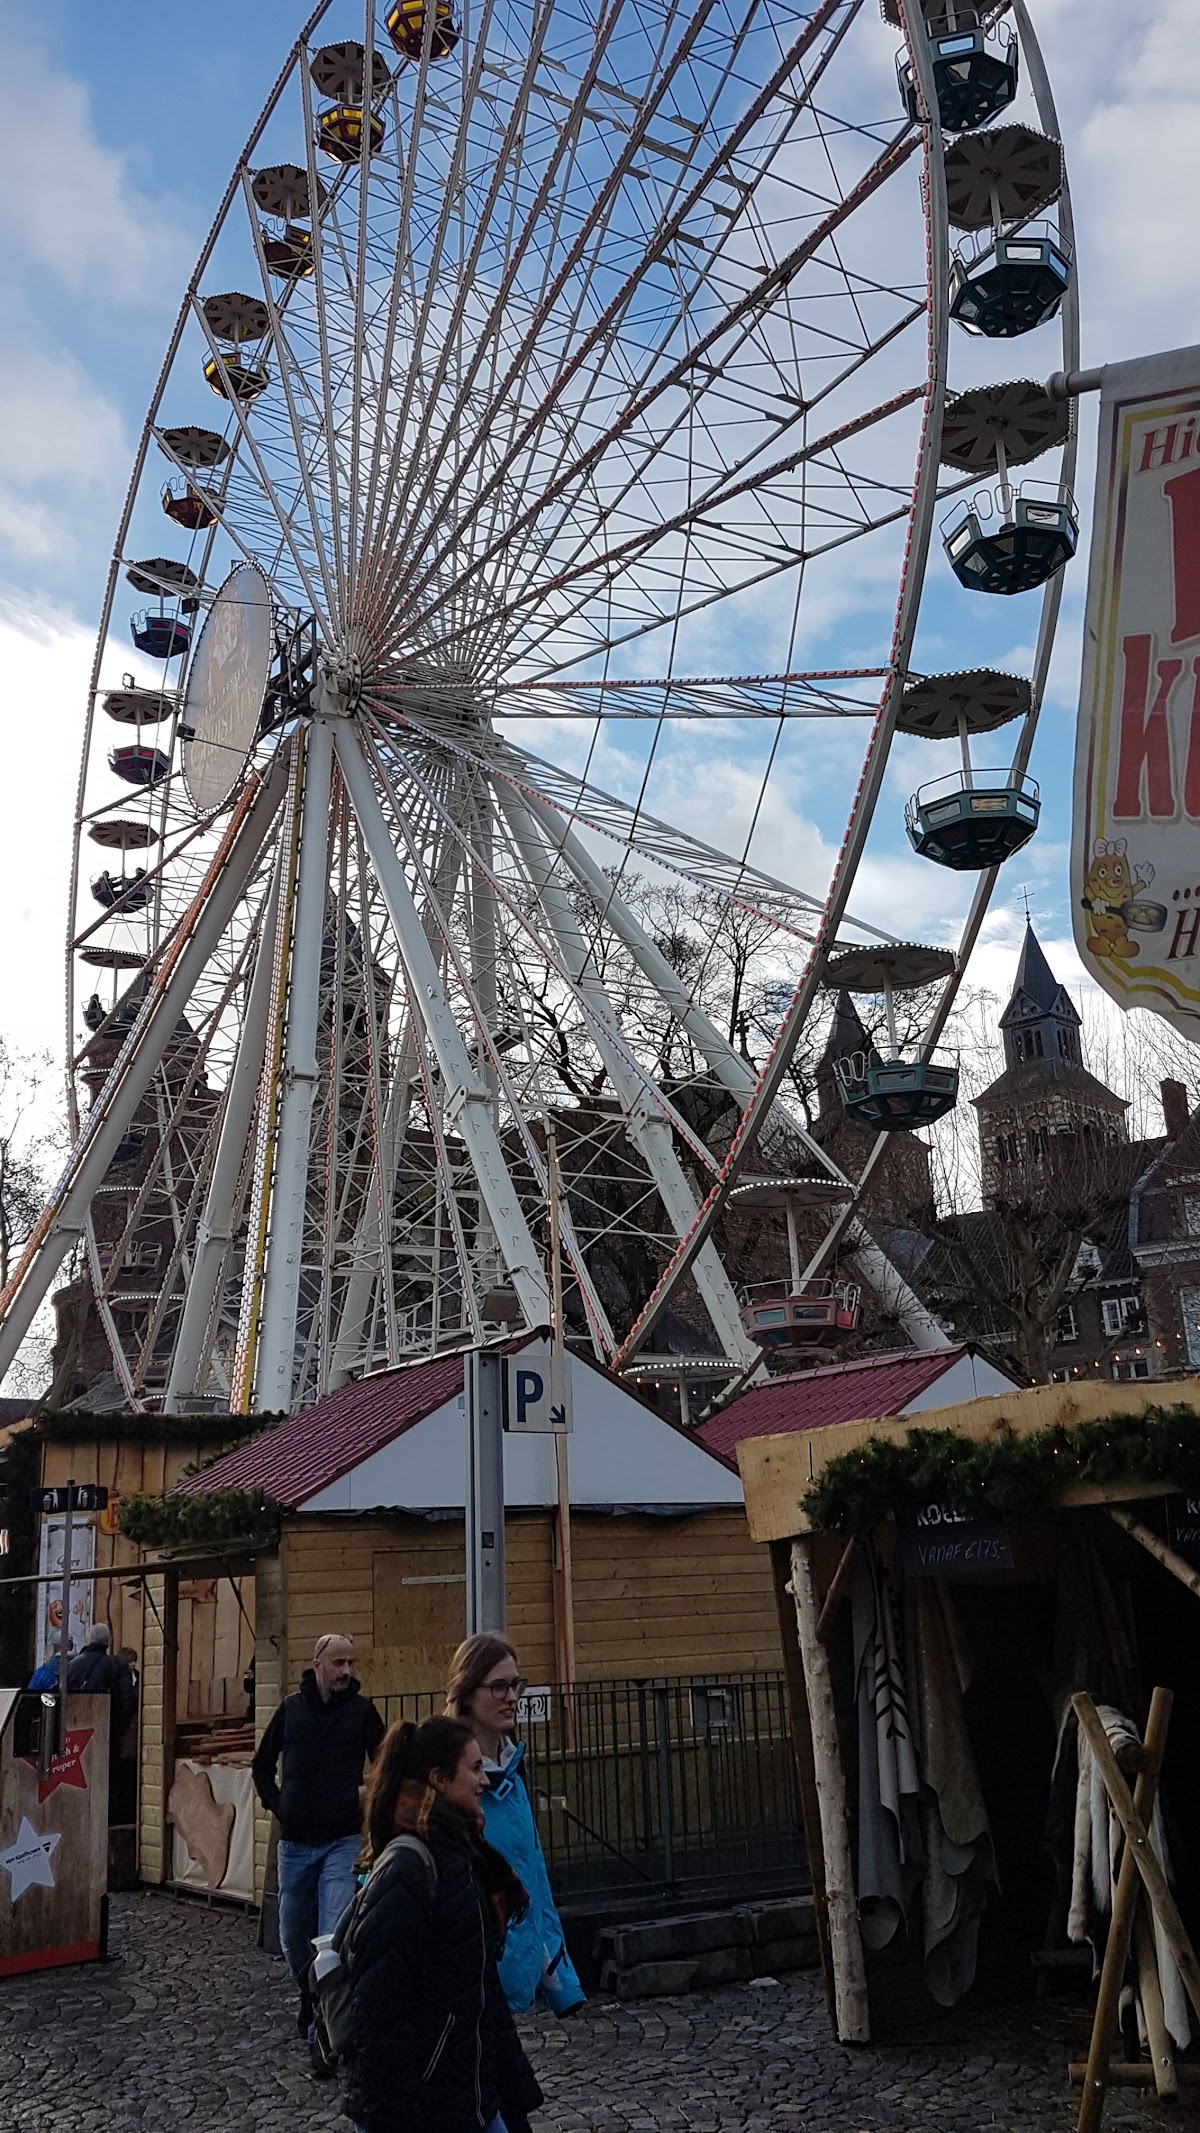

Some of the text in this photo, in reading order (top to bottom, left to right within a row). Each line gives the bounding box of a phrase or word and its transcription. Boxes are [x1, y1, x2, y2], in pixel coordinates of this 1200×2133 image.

[1138, 417, 1200, 473] Hi
[516, 1370, 544, 1423] P
[917, 1543, 963, 1567] VANAF
